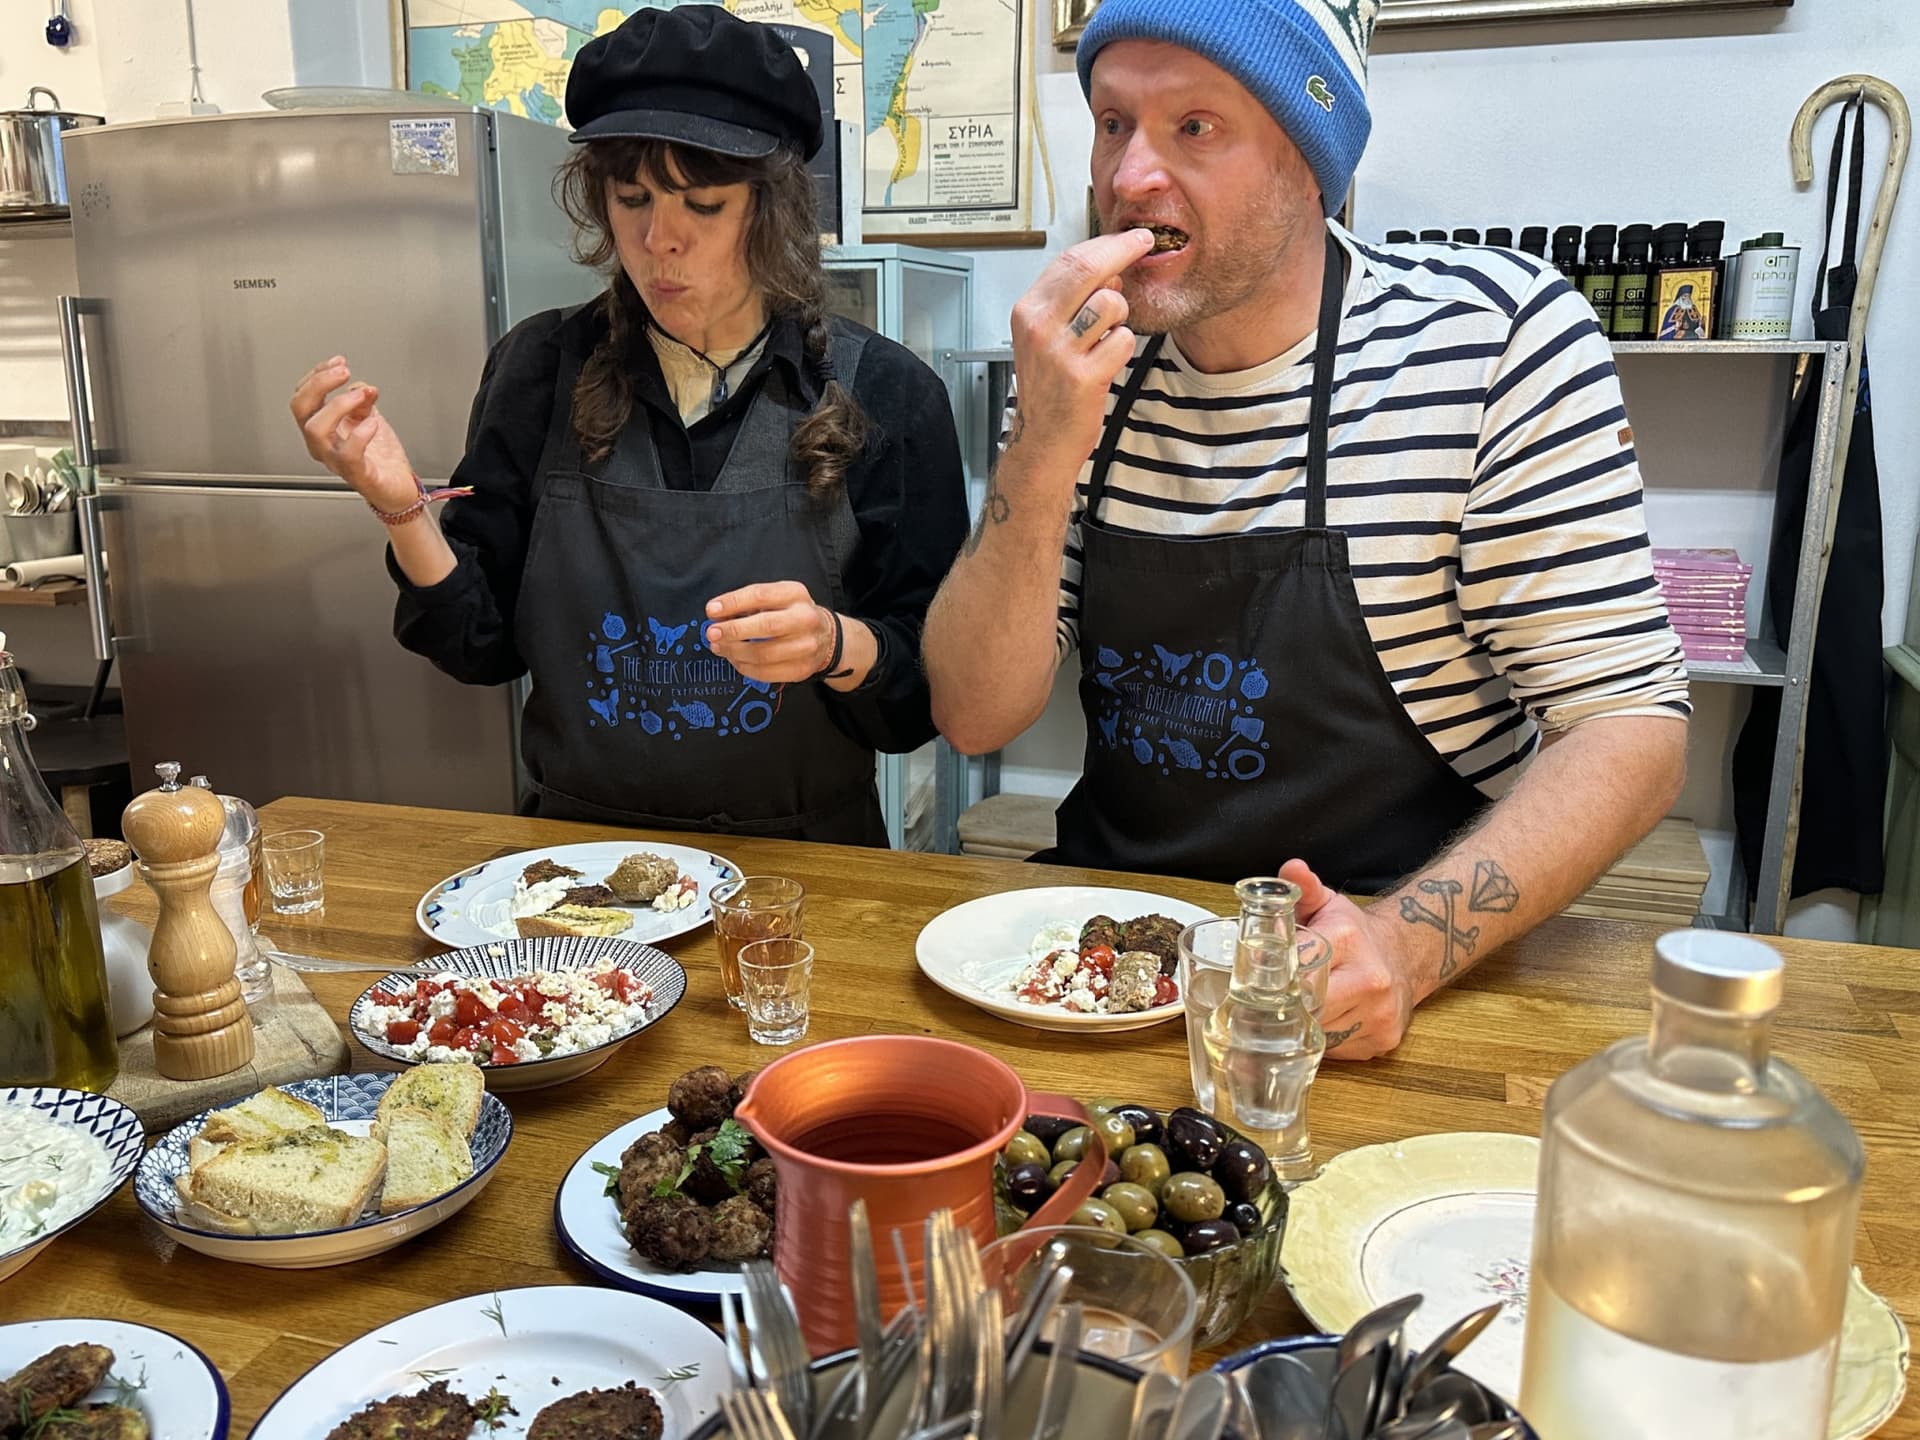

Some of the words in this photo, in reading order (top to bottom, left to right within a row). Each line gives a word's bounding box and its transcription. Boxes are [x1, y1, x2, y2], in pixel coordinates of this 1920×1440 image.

[948, 124, 993, 139] ΣΥΡΙΑ
[233, 278, 277, 289] SIEMENS
[1752, 270, 1786, 282] alpha
[621, 655, 641, 683] THE
[648, 660, 680, 685] REEK
[1145, 684, 1181, 716] GREEK
[1179, 692, 1227, 727] KITCHEN
